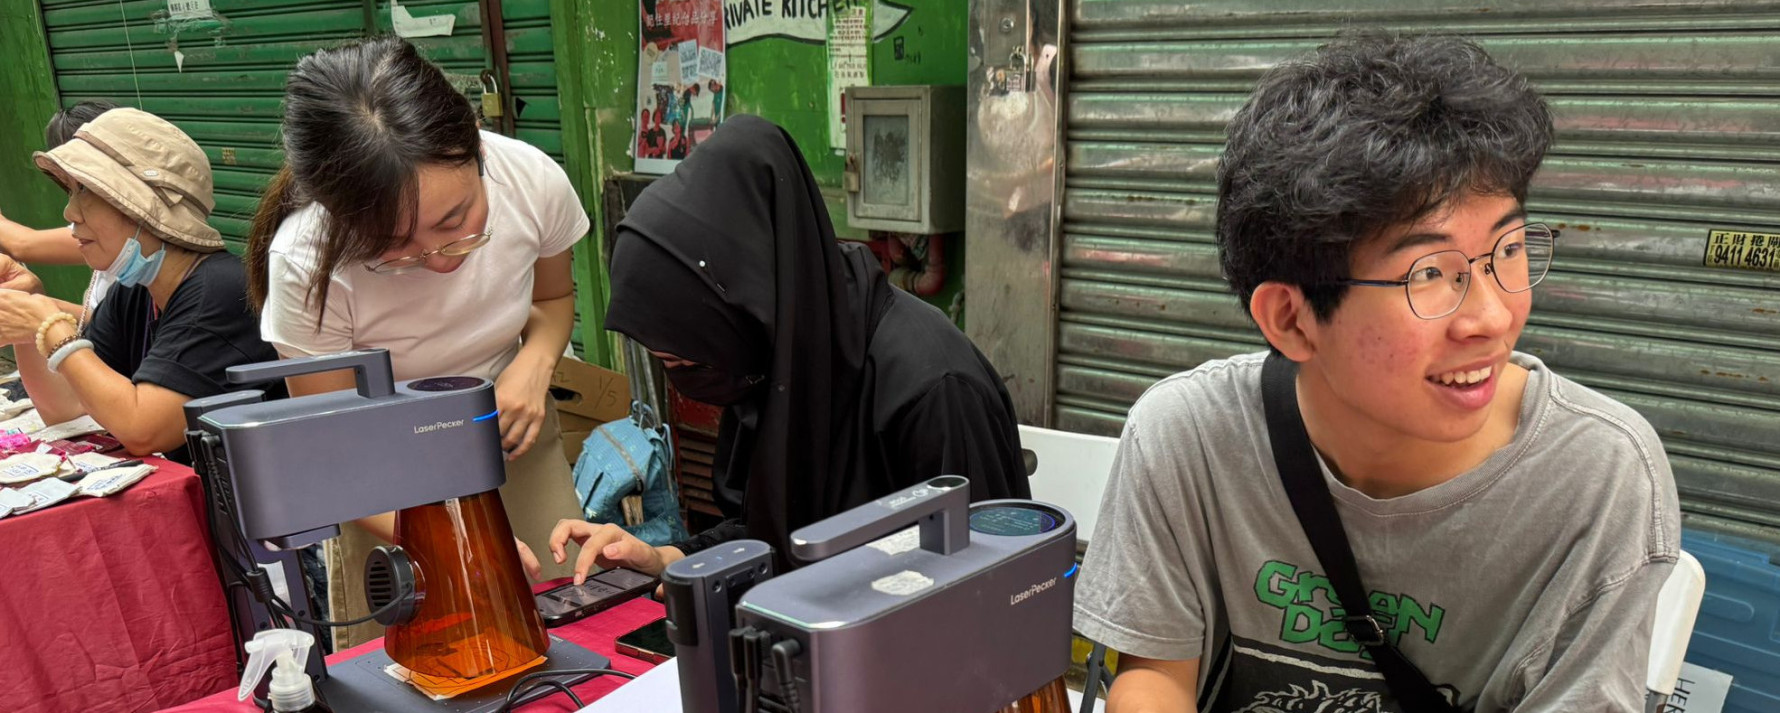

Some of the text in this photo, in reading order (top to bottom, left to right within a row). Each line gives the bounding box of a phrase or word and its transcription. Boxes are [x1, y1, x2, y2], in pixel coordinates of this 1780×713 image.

[1714, 244, 1744, 265] 9411
[1744, 246, 1776, 268] 4631
[413, 419, 465, 434] LaserPecker
[1010, 577, 1057, 606] LaserPecker
